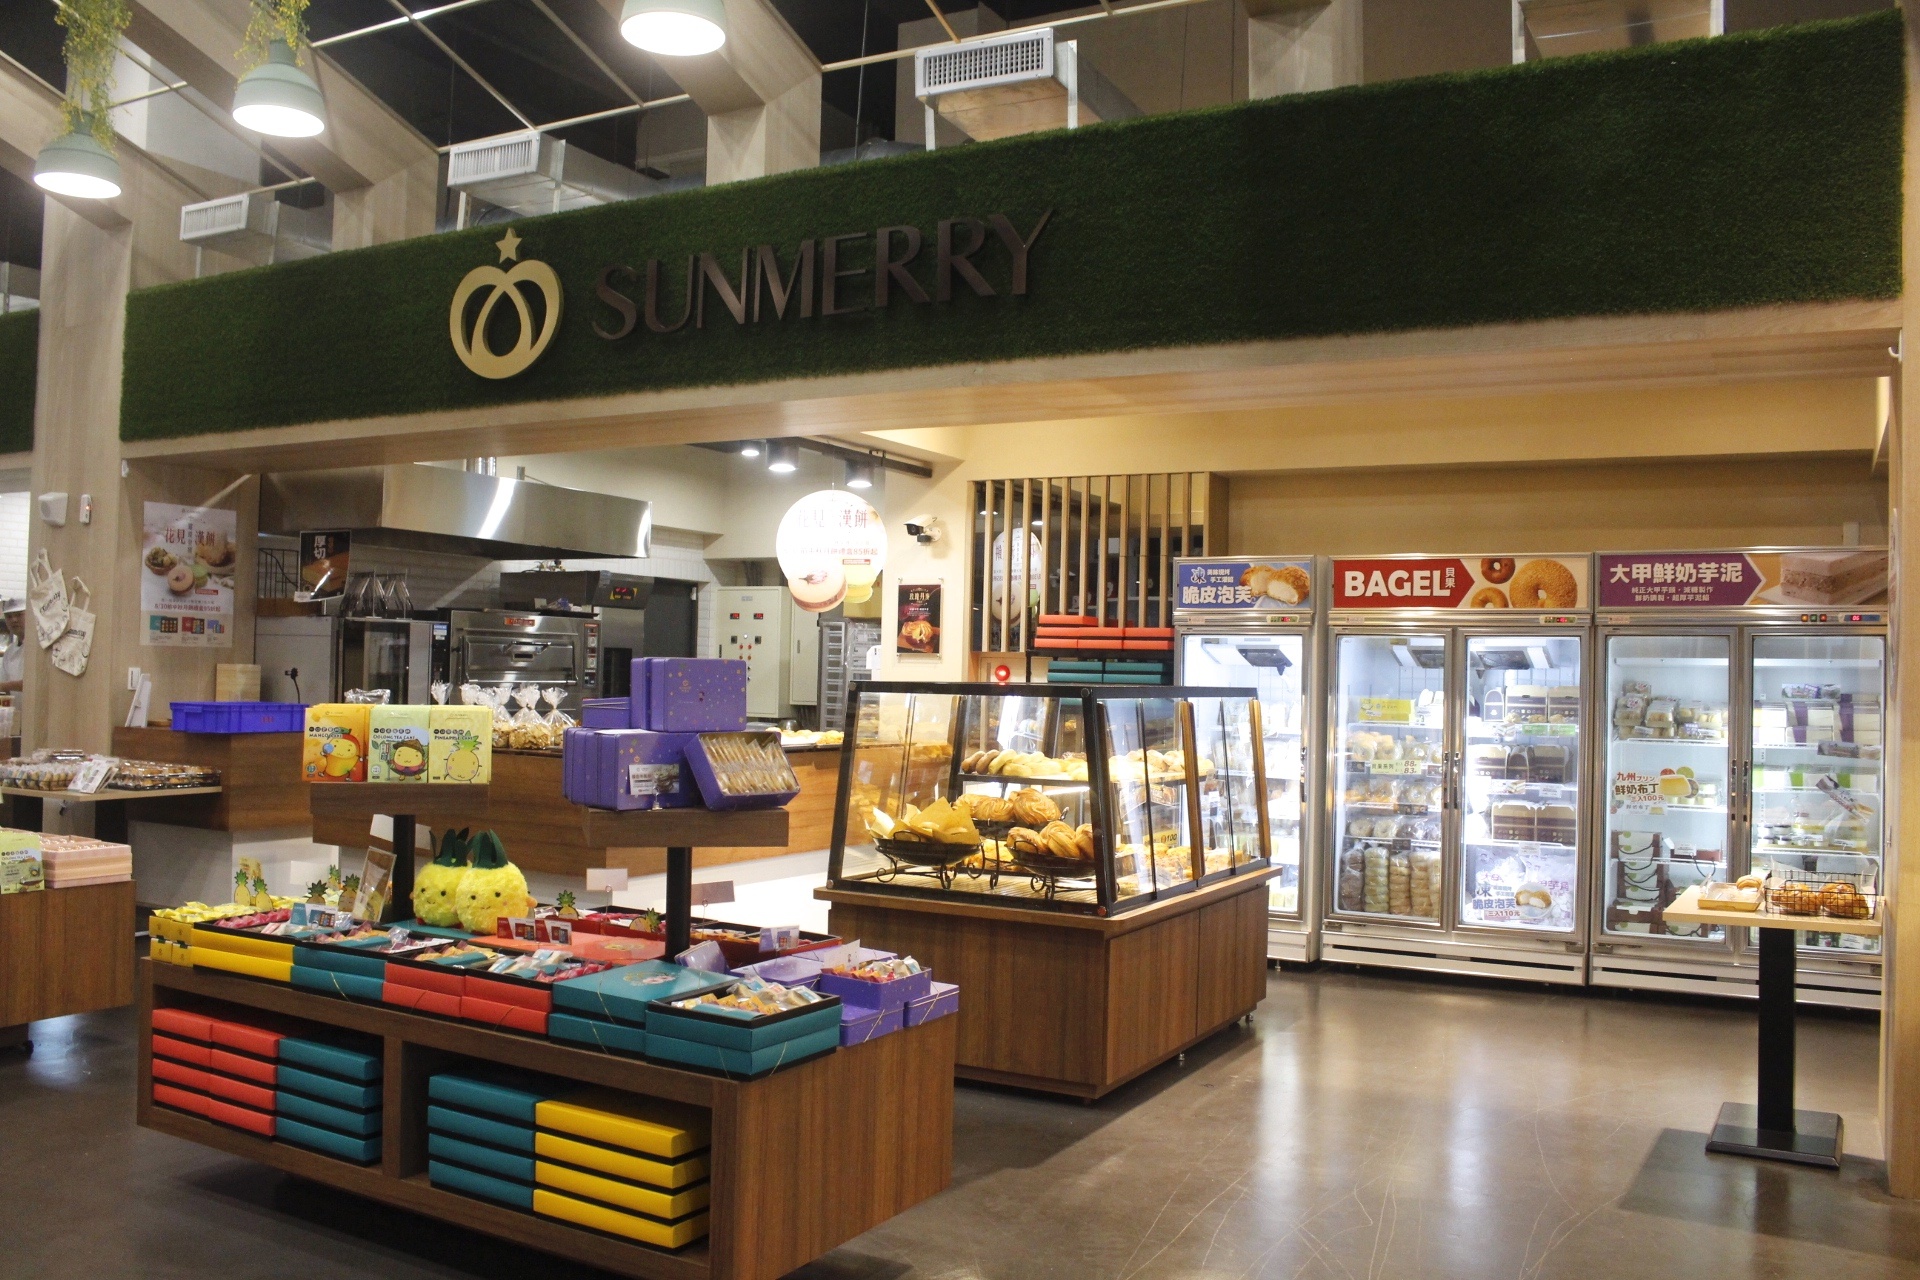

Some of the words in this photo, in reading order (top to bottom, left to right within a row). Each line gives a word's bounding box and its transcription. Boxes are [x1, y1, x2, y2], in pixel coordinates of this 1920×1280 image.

[591, 207, 1055, 341] SUNMERRY
[839, 508, 868, 528] 漢餅
[1344, 569, 1450, 597] BAGEL
[1445, 567, 1456, 588] 貝果
[1609, 562, 1743, 584] 大甲鮮奶芋泥
[1182, 585, 1253, 605] 脆皮泡芙
[1615, 783, 1659, 795] 鮮奶布丁
[1473, 898, 1516, 910] 脆皮泡芙
